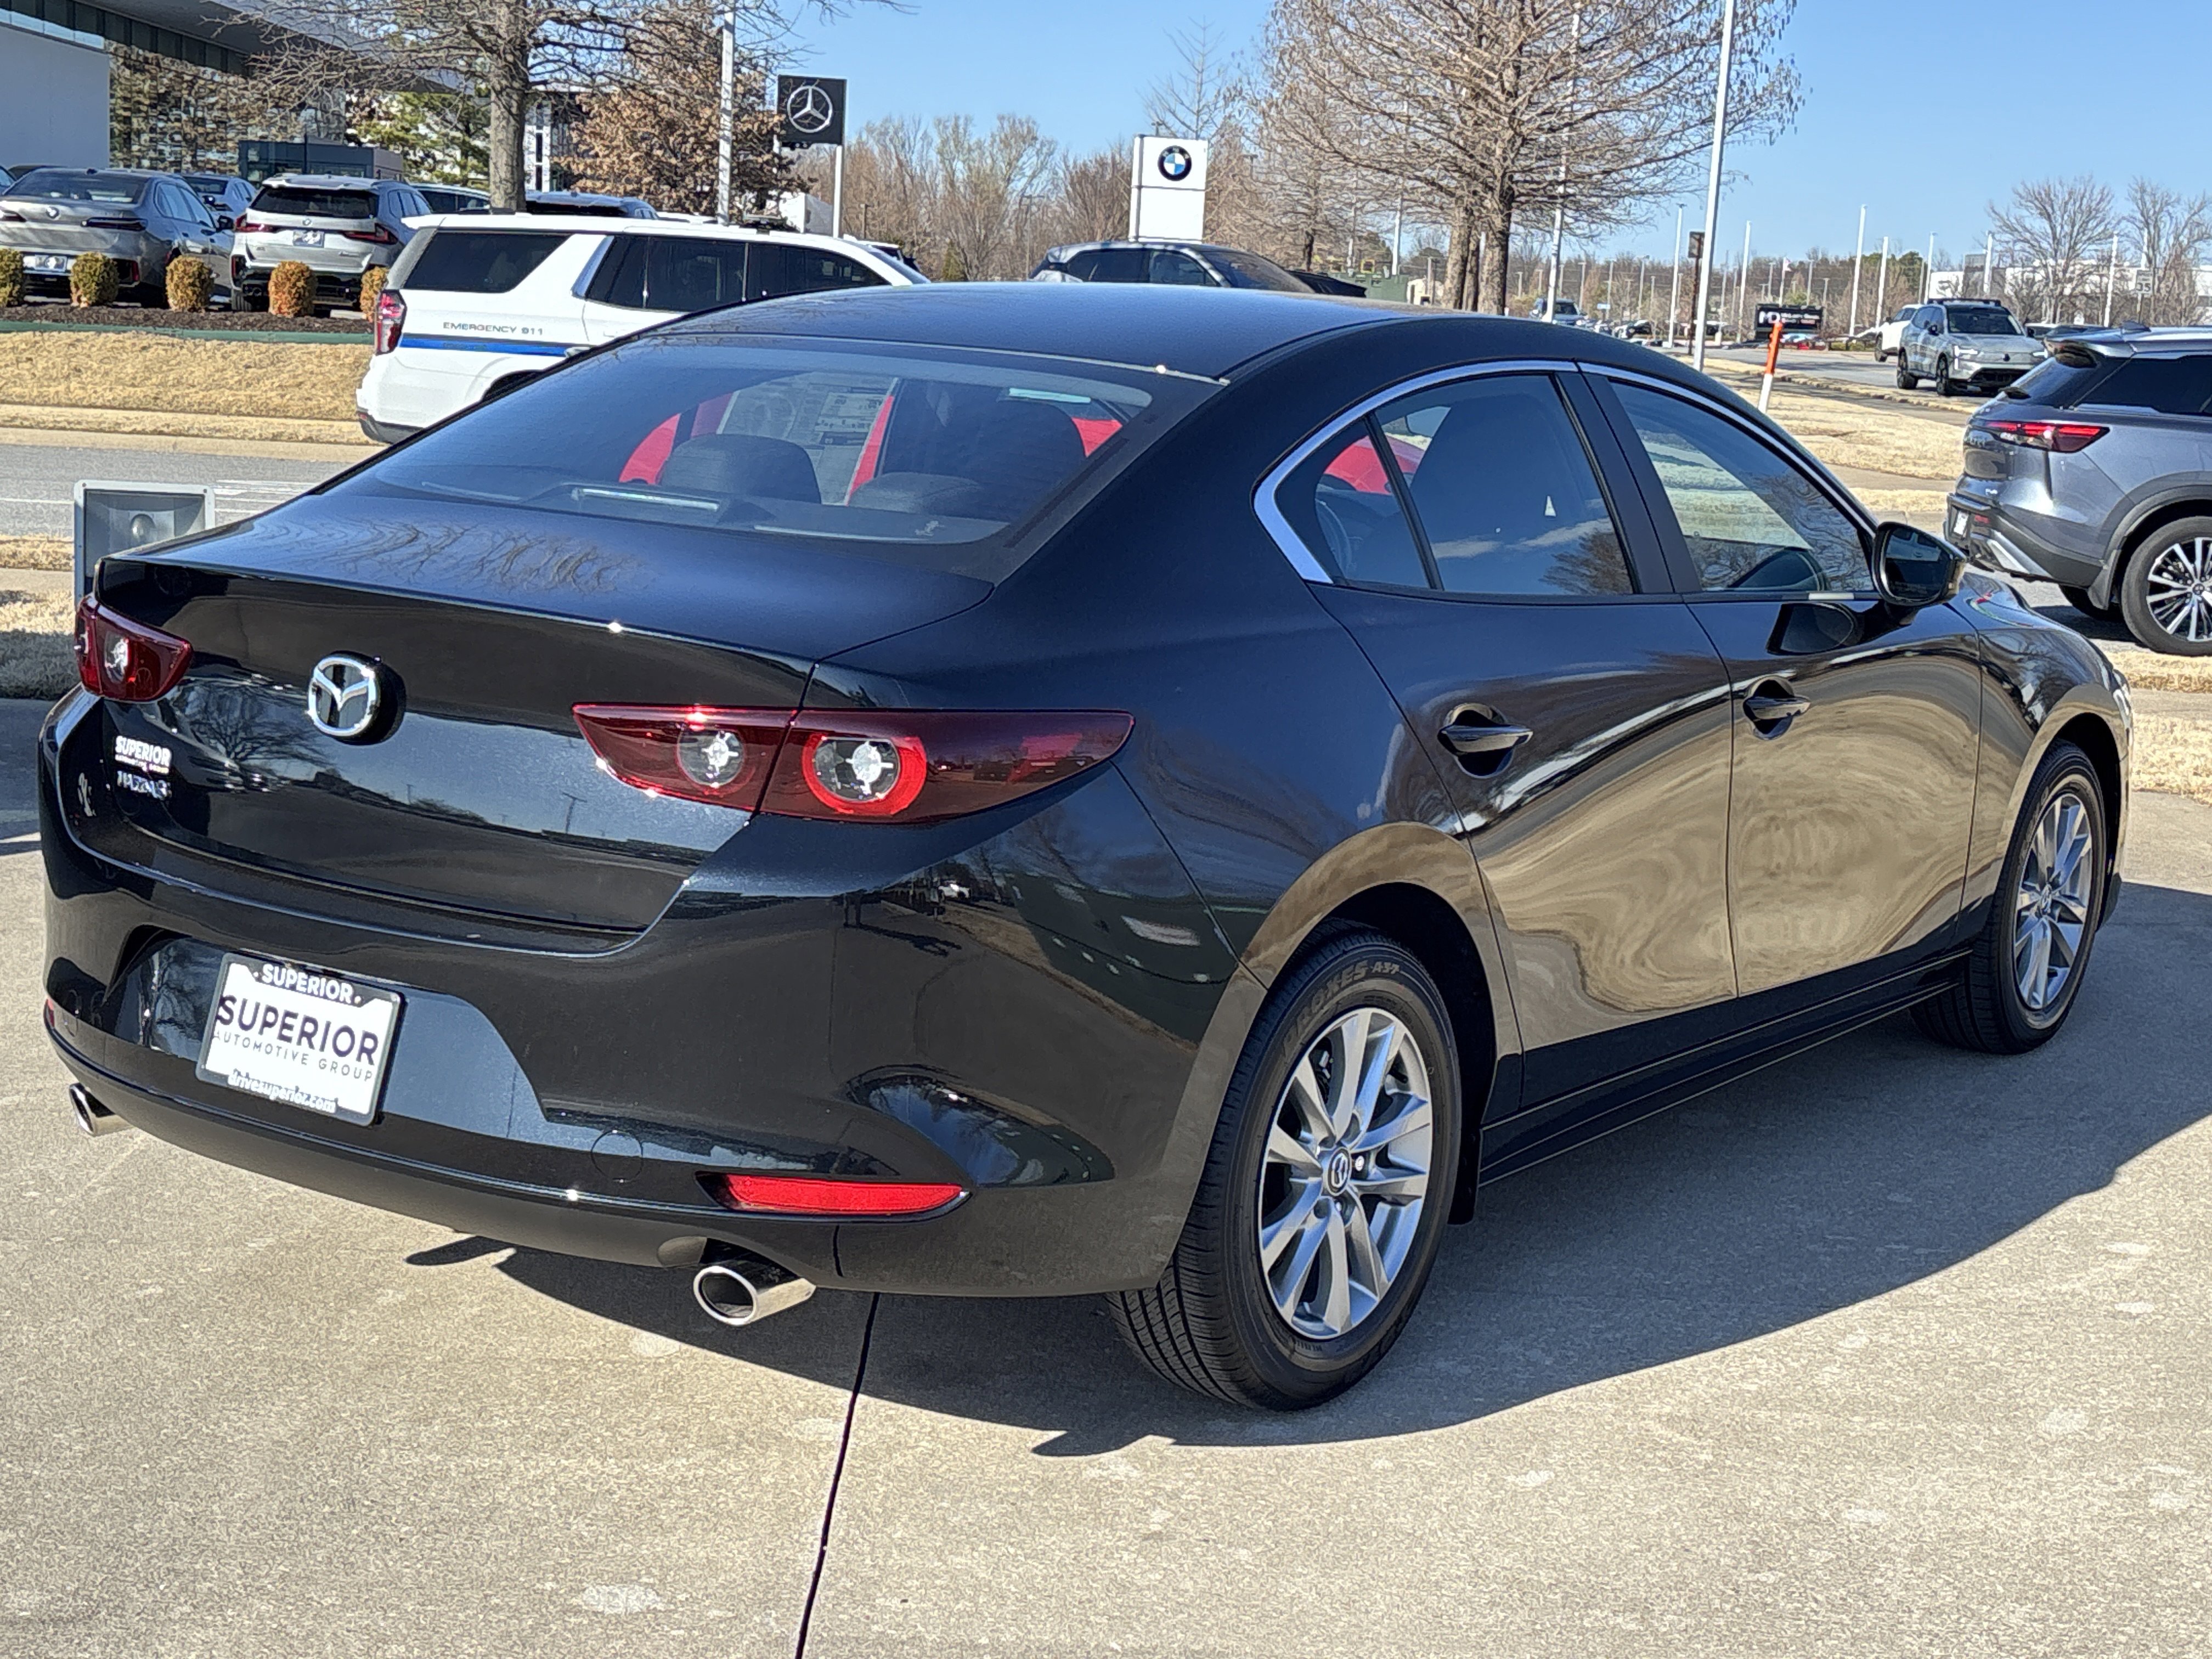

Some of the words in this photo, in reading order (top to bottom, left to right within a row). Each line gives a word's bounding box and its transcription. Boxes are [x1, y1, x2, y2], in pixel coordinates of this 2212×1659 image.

[443, 321, 517, 334] EMERGENCY
[521, 326, 543, 336] 911
[115, 735, 172, 768] SUPERIOR
[262, 963, 354, 1004] SUPERIOR
[216, 994, 379, 1066] SUPERIOR
[213, 1030, 309, 1065] AUTOMOTIVE
[318, 1058, 373, 1082] GROUP
[227, 1069, 337, 1114] drivesuperior.com
